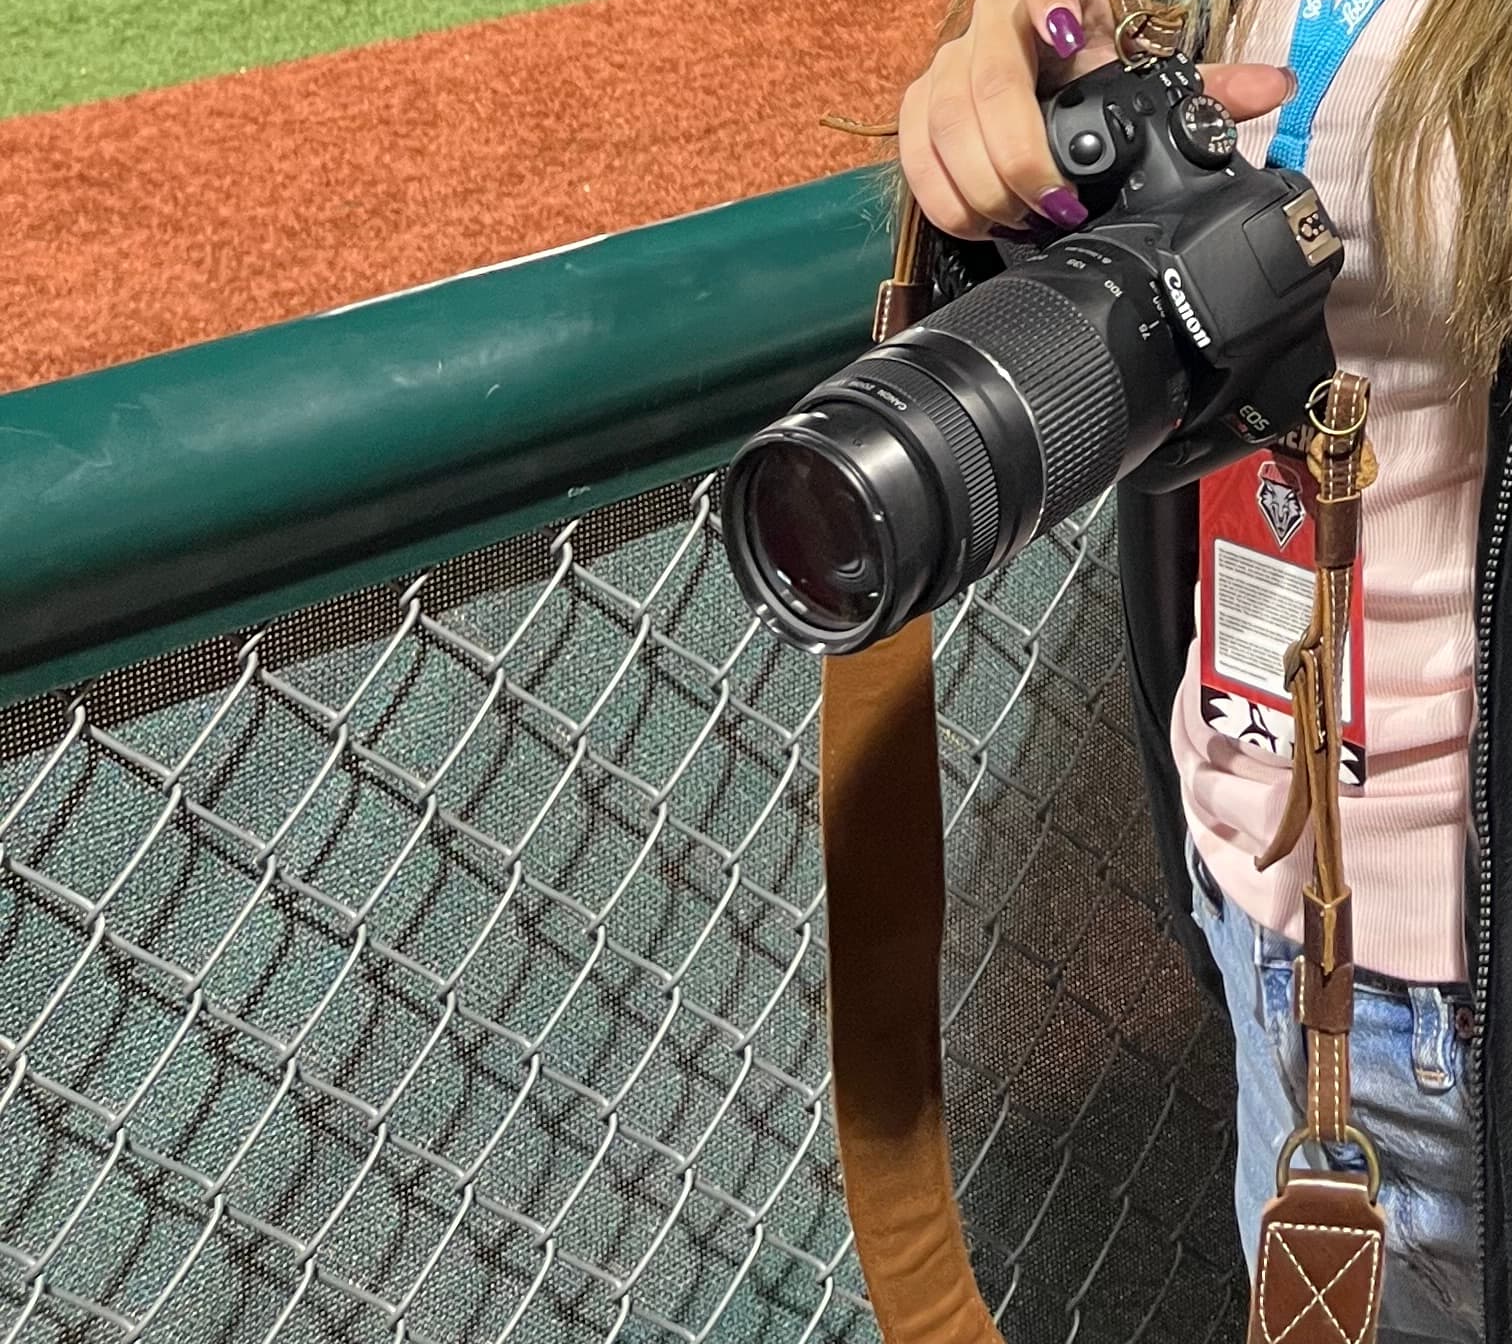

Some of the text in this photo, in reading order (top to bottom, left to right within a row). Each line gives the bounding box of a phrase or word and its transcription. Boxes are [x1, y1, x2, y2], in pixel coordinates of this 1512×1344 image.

[1103, 279, 1123, 298] 100
[1163, 267, 1212, 349] Canon
[1239, 404, 1271, 432] EOS
